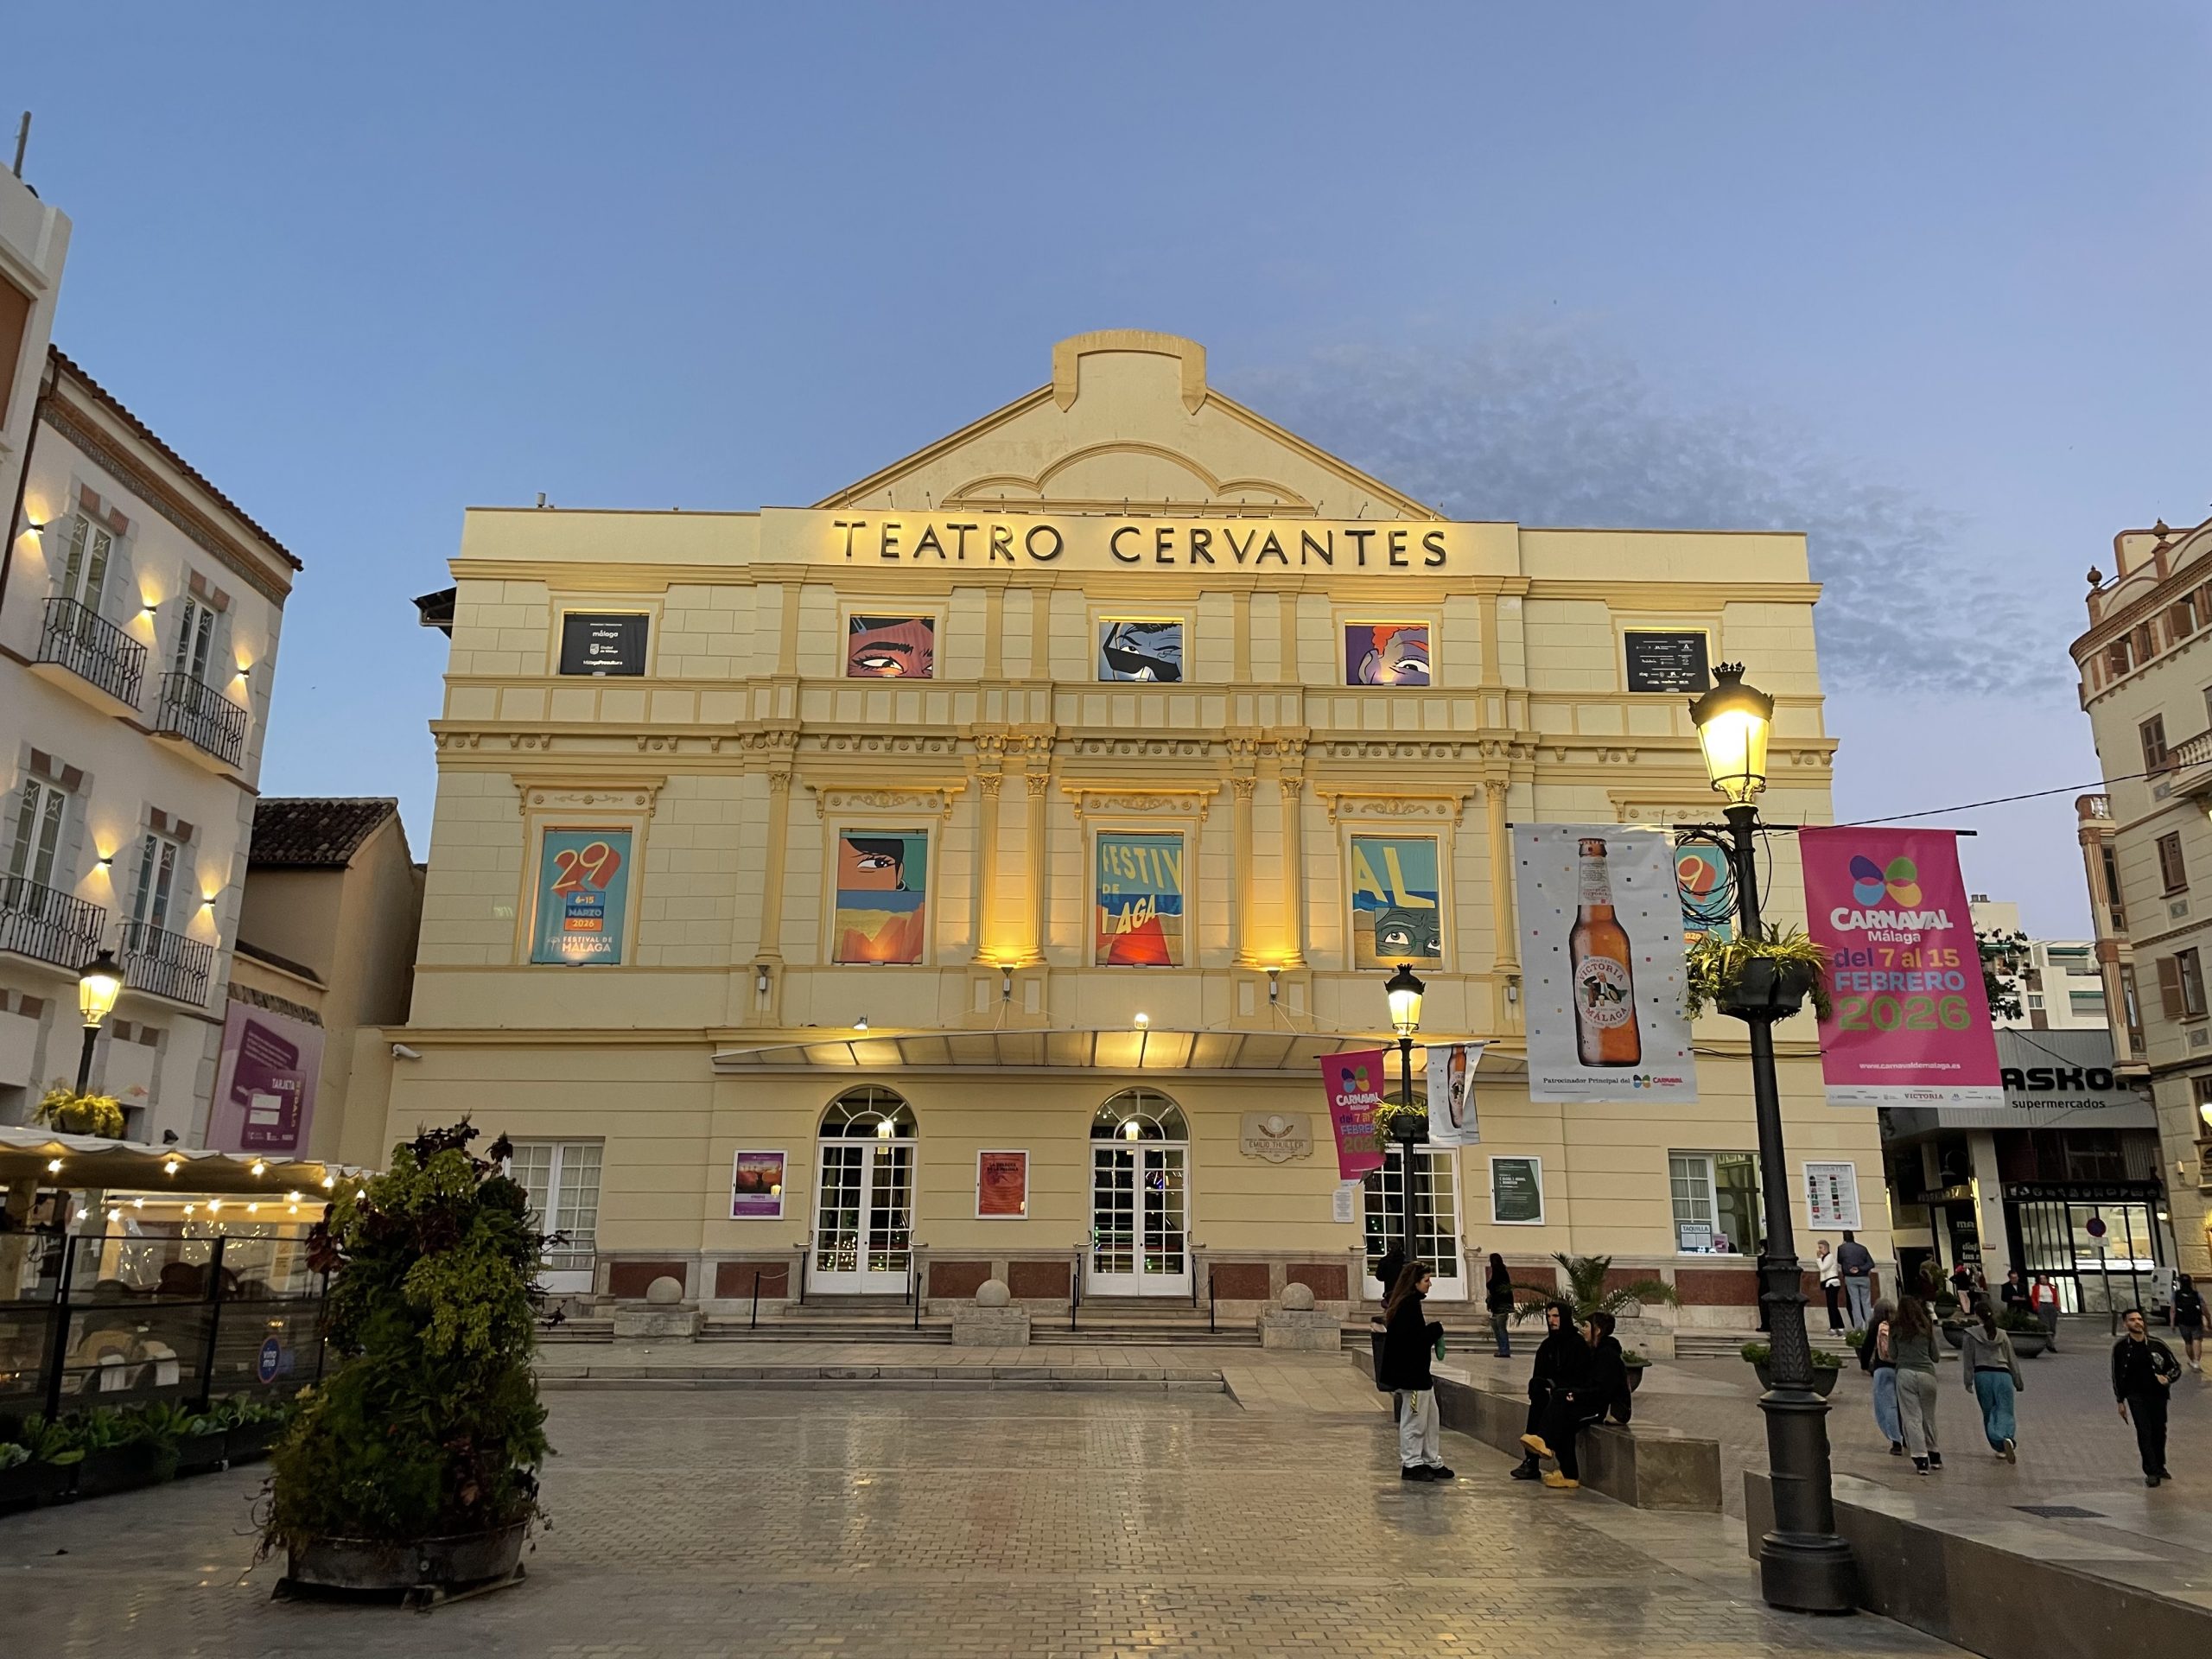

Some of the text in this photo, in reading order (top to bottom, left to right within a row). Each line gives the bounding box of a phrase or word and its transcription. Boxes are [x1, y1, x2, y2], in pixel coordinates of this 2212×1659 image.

[834, 520, 1446, 567] TEATRO CERVANTES
[550, 841, 609, 890] 29
[1678, 855, 1704, 891] 9
[1352, 844, 1436, 909] AL
[575, 895, 594, 904] 6-15
[569, 907, 602, 917] MARZO
[1830, 907, 1954, 931] CARNAVAL
[572, 918, 594, 928] 2026
[1867, 931, 1922, 944] Málaga
[1834, 947, 1961, 968] del 7 al 15
[1580, 963, 1624, 982] VICTORIA
[1834, 970, 1966, 992] FEBRERO
[1838, 995, 1971, 1031] 2026
[1859, 1062, 1961, 1071] www.carnavaldemalaga.es
[1588, 1077, 1618, 1085] Principal
[2000, 1067, 2126, 1090] ASKO
[2012, 1098, 2107, 1111] supermercados
